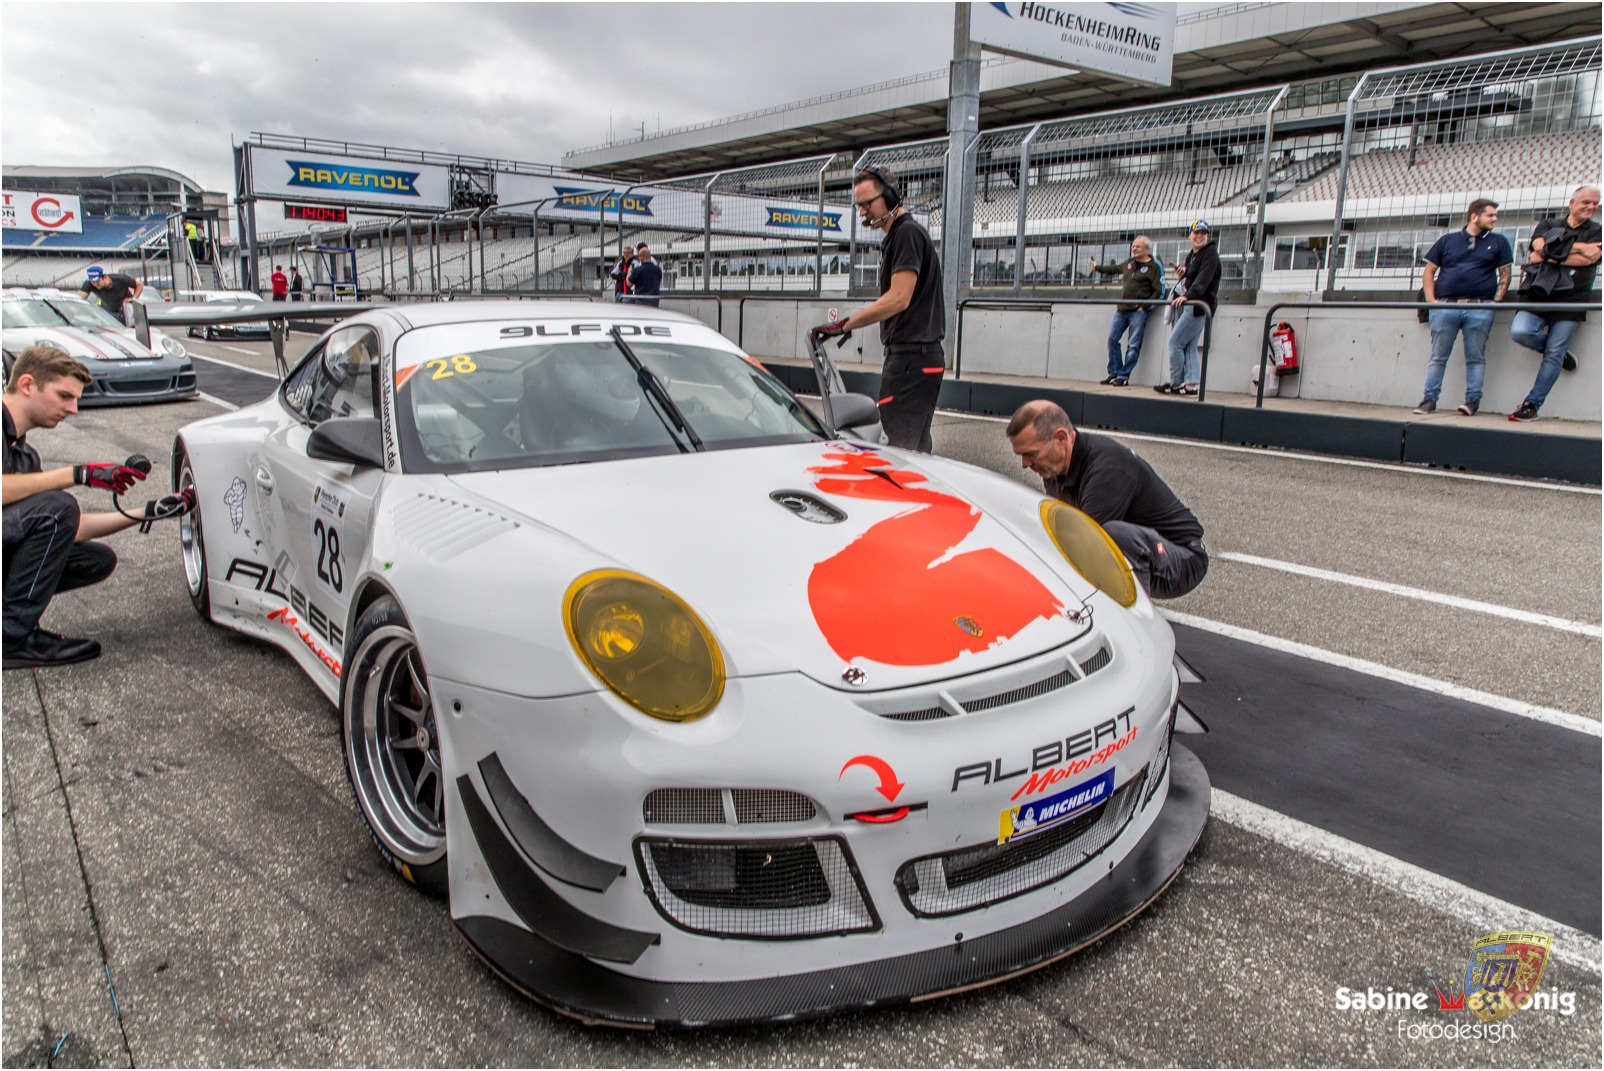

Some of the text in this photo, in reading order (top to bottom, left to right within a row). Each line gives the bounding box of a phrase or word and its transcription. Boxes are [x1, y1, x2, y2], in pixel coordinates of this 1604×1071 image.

[1061, 33, 1157, 64] BADEN-WÜRTTEMBERG
[299, 167, 410, 190] RAVENOL
[562, 192, 646, 212] RAVENOL
[772, 211, 837, 228] RAVENOL
[426, 354, 477, 380] 28
[314, 518, 343, 594] 28
[951, 705, 1136, 793] ALBERT
[1010, 725, 1139, 801] Motorsport
[1038, 781, 1106, 822] MICHELIN
